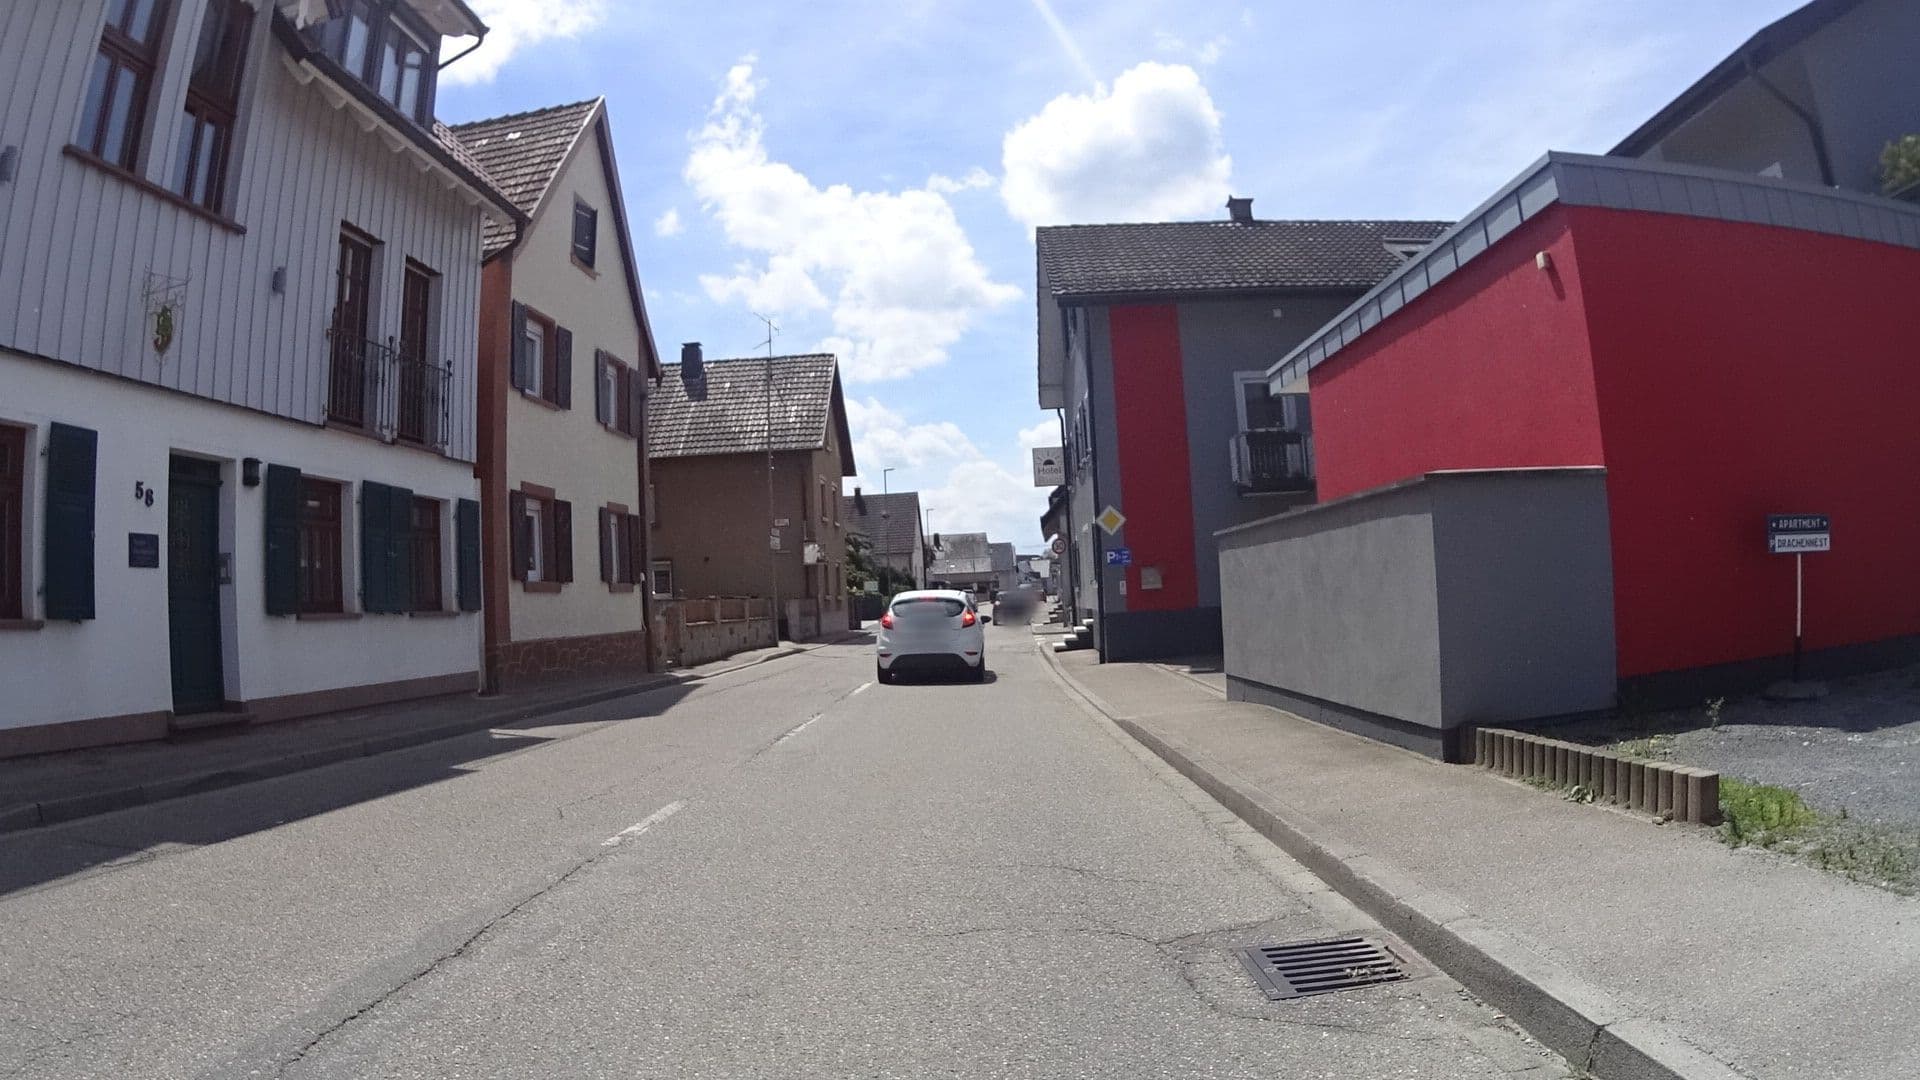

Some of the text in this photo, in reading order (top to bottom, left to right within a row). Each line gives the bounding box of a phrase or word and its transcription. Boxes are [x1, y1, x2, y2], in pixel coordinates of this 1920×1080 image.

[1037, 466, 1062, 474] Hotel
[1778, 518, 1821, 529] APARTMENT
[1777, 537, 1828, 548] DRACHENNEST
